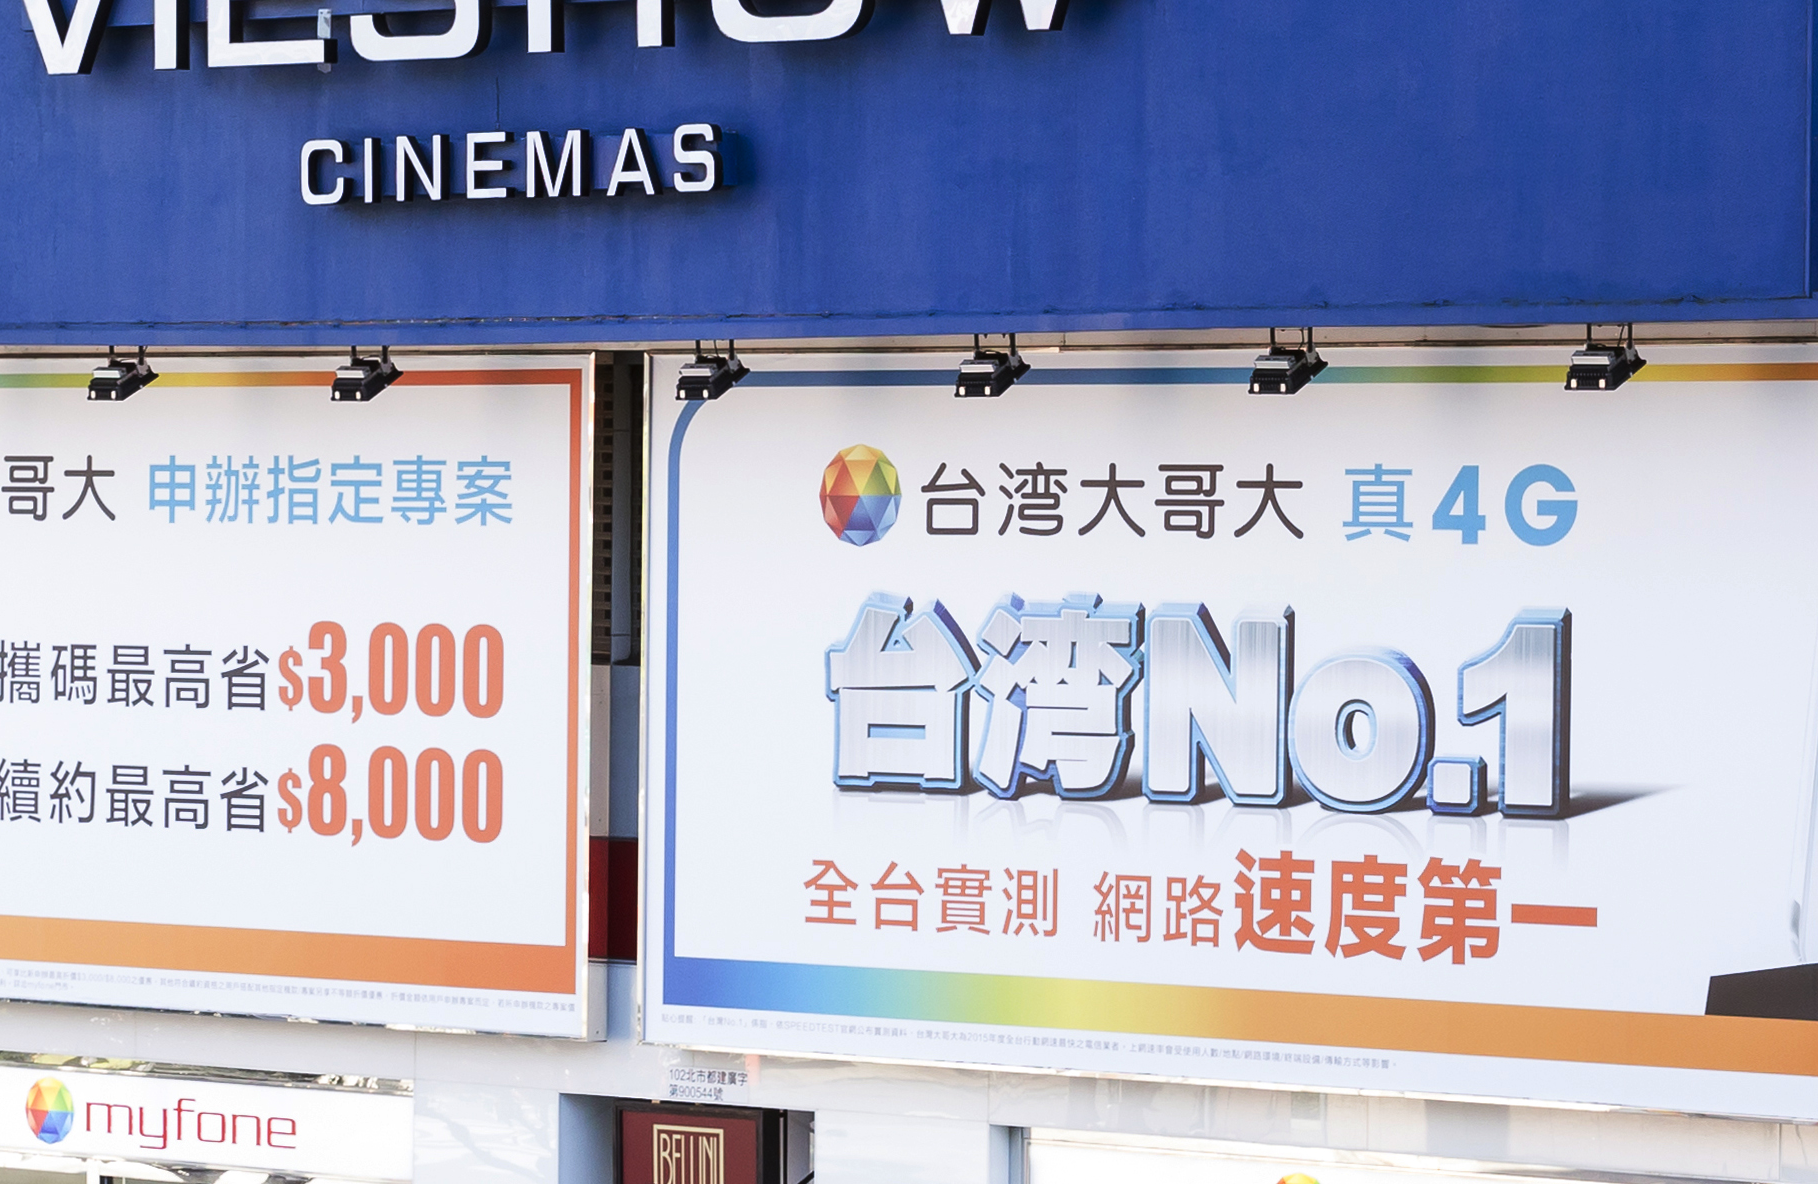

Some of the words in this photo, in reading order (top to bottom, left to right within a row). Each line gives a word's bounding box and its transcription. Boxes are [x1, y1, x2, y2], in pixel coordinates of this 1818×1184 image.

[299, 122, 721, 207] CINEMAS
[147, 454, 515, 527] 申辦指定專案
[803, 858, 1060, 938] 全台實測
[1092, 850, 1599, 966] 網路速度第一
[85, 1097, 297, 1150] myfone
